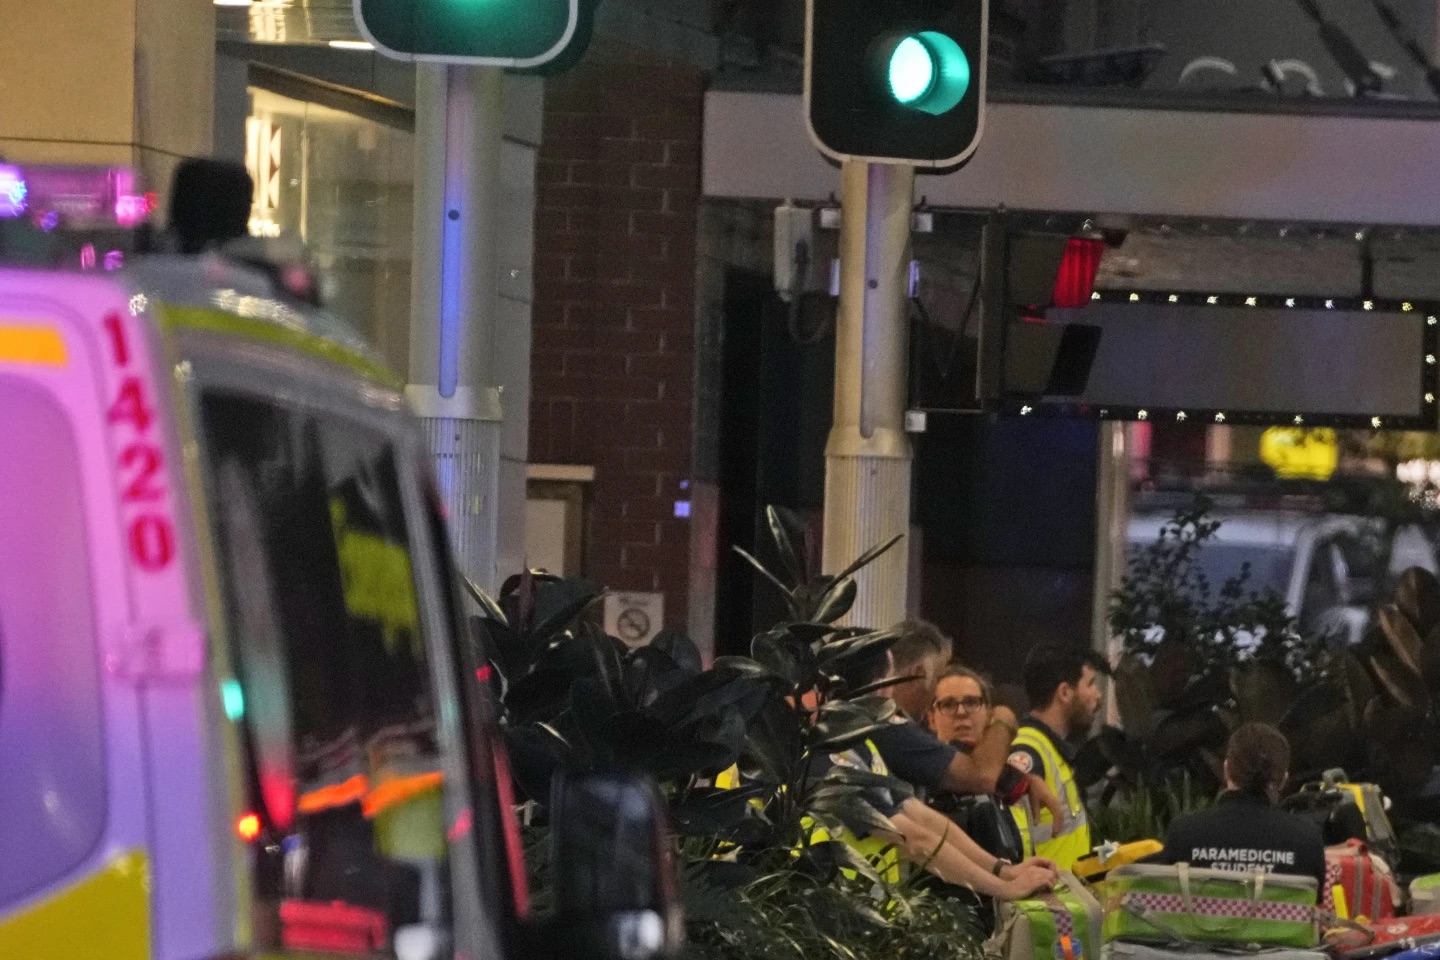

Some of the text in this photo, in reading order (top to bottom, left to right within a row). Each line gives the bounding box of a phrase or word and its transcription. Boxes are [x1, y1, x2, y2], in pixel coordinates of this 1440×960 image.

[103, 311, 176, 573] 1420
[1191, 847, 1295, 865] PARAMEDICINE
[1211, 861, 1275, 873] STUDENT
